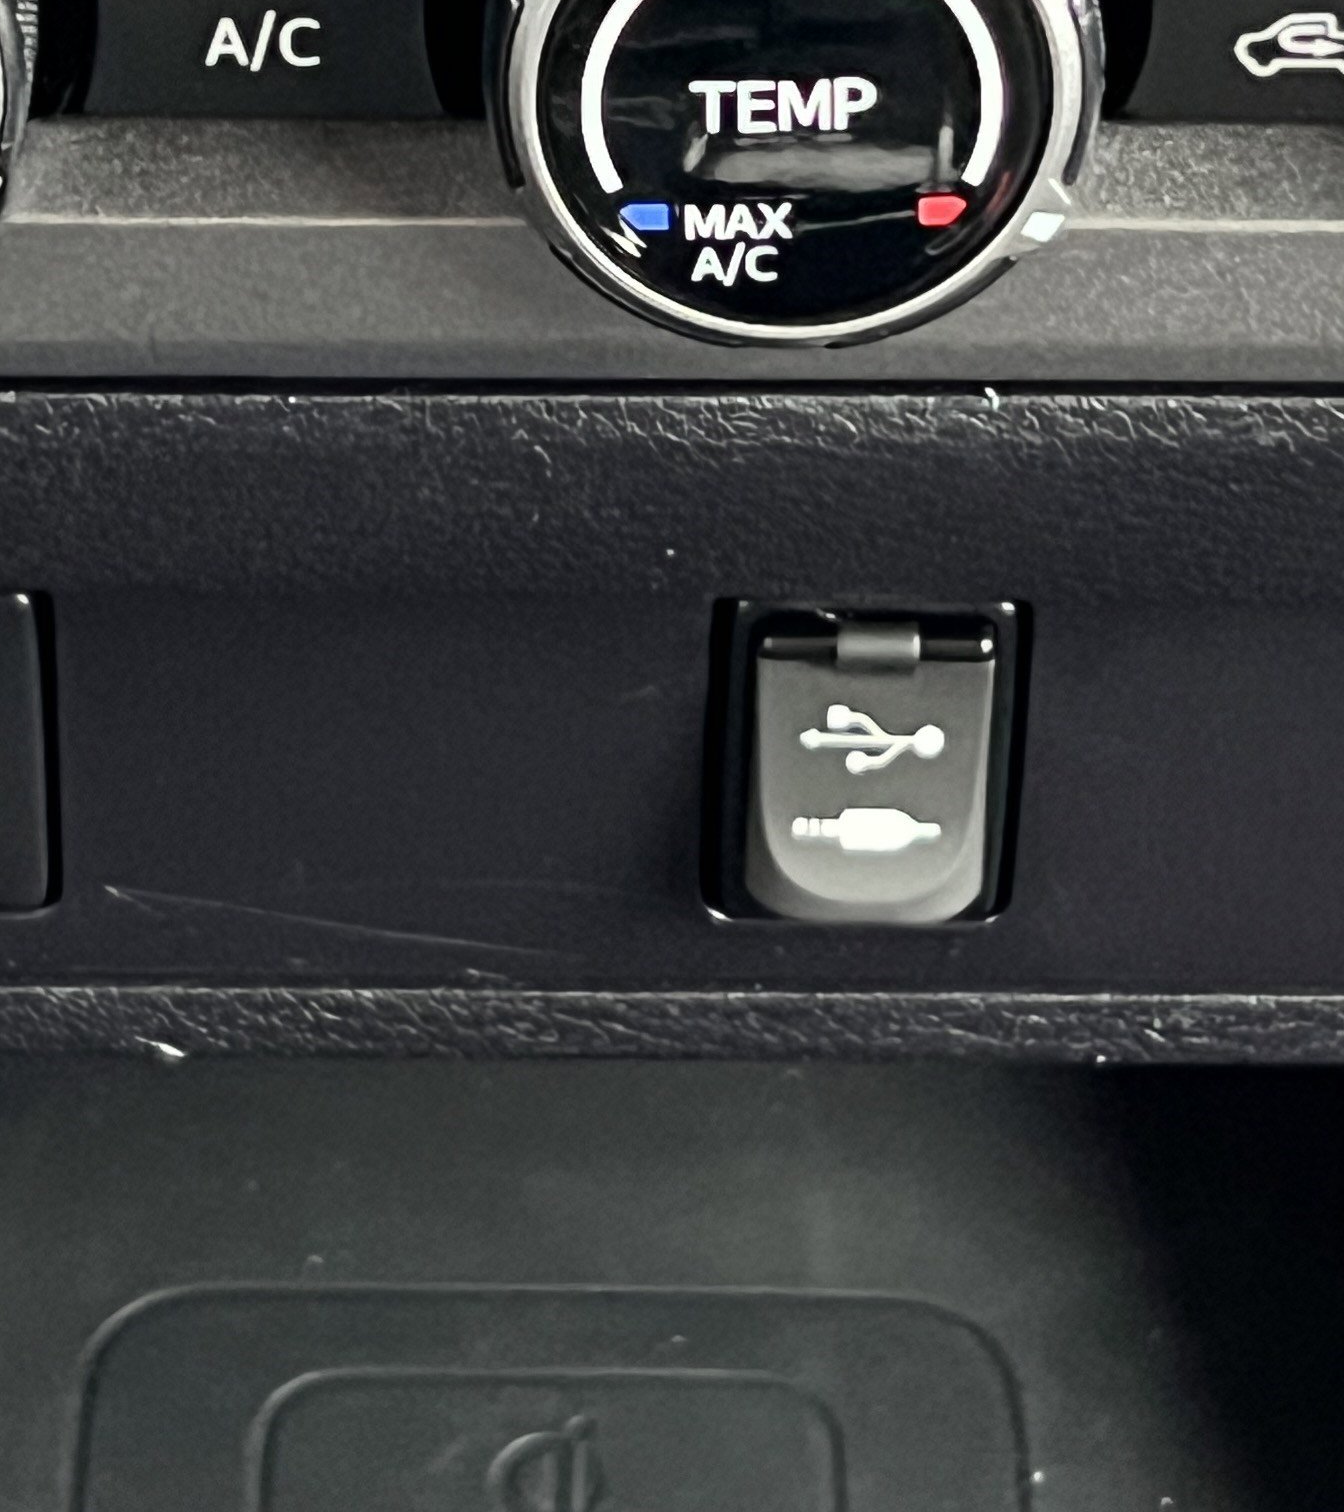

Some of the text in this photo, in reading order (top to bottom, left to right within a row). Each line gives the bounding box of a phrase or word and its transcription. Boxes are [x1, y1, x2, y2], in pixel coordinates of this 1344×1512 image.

[205, 9, 321, 72] A/C
[688, 76, 878, 135] TEMP
[684, 201, 794, 242] MAX
[690, 244, 779, 287] A/C
